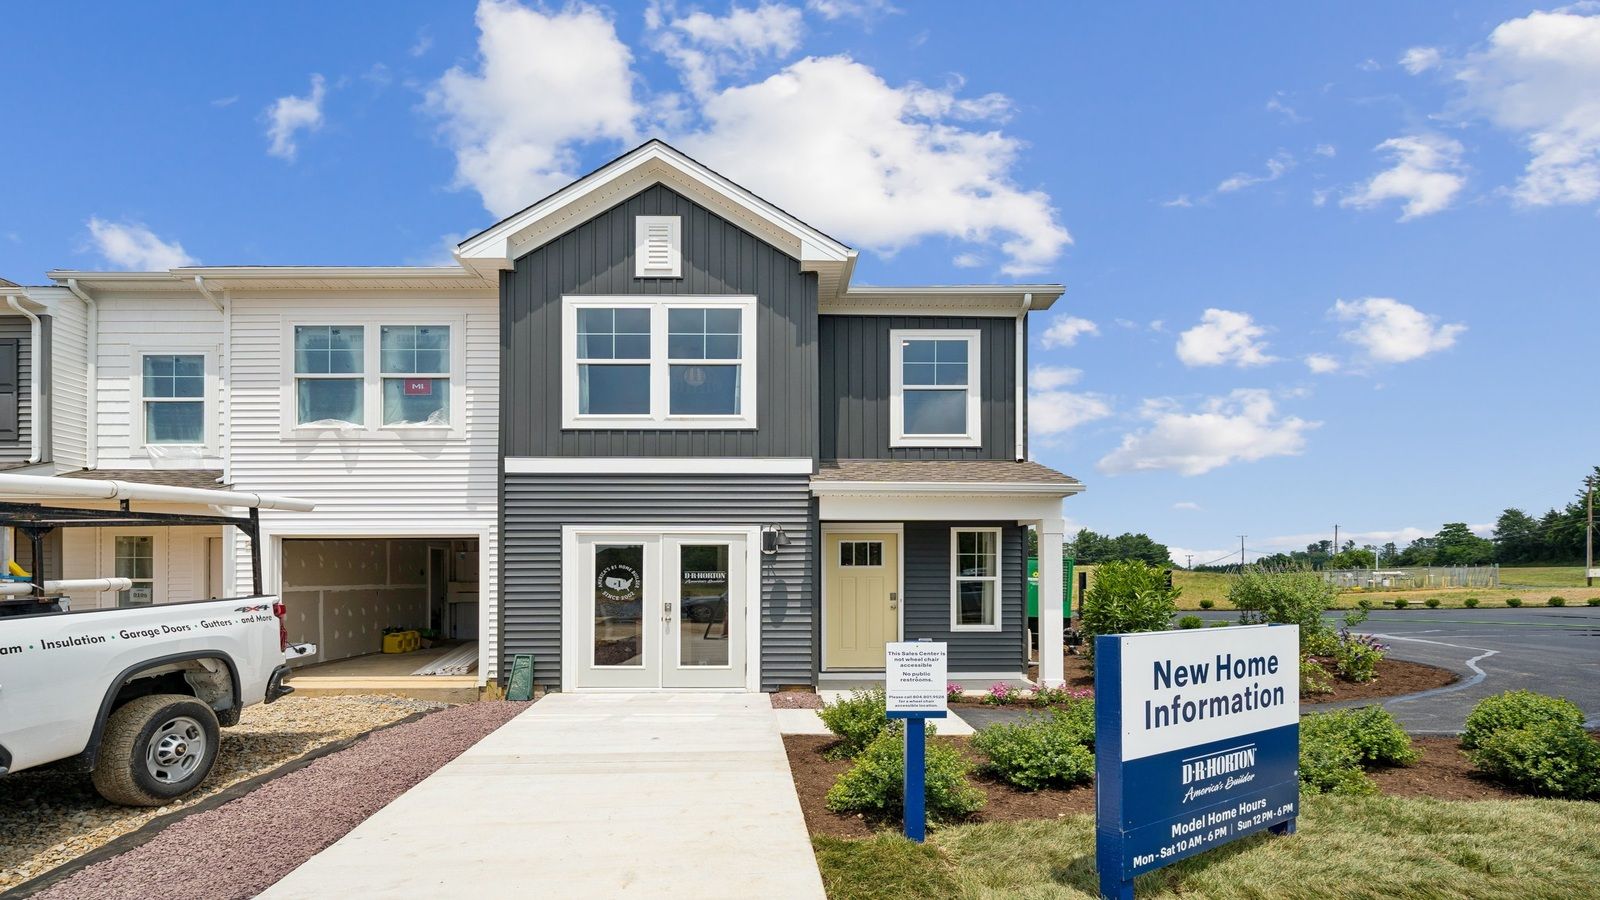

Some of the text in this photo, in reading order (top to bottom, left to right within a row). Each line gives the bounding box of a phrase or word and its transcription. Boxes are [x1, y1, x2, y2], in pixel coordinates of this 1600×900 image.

[40, 634, 106, 650] Insulation
[119, 627, 160, 640] Garage
[161, 624, 192, 634] Doors
[200, 619, 233, 629] Gutters
[241, 615, 255, 624] and
[256, 614, 273, 622] More
[1153, 653, 1279, 691] New Home
[1145, 682, 1285, 730] Information
[1182, 773, 1255, 804] America's Builder
[1133, 853, 1155, 868] Mon
[1160, 845, 1176, 859] Sat
[1176, 840, 1187, 852] 10
[1188, 834, 1202, 848] AM
[1207, 831, 1214, 842] 6
[1214, 826, 1227, 840] PM
[1237, 820, 1252, 831] Sun
[1252, 814, 1261, 826] 12
[1262, 809, 1273, 823] PM
[1277, 807, 1283, 817] 6
[1283, 802, 1294, 814] PM
[1171, 798, 1267, 838] Model Home Hours
